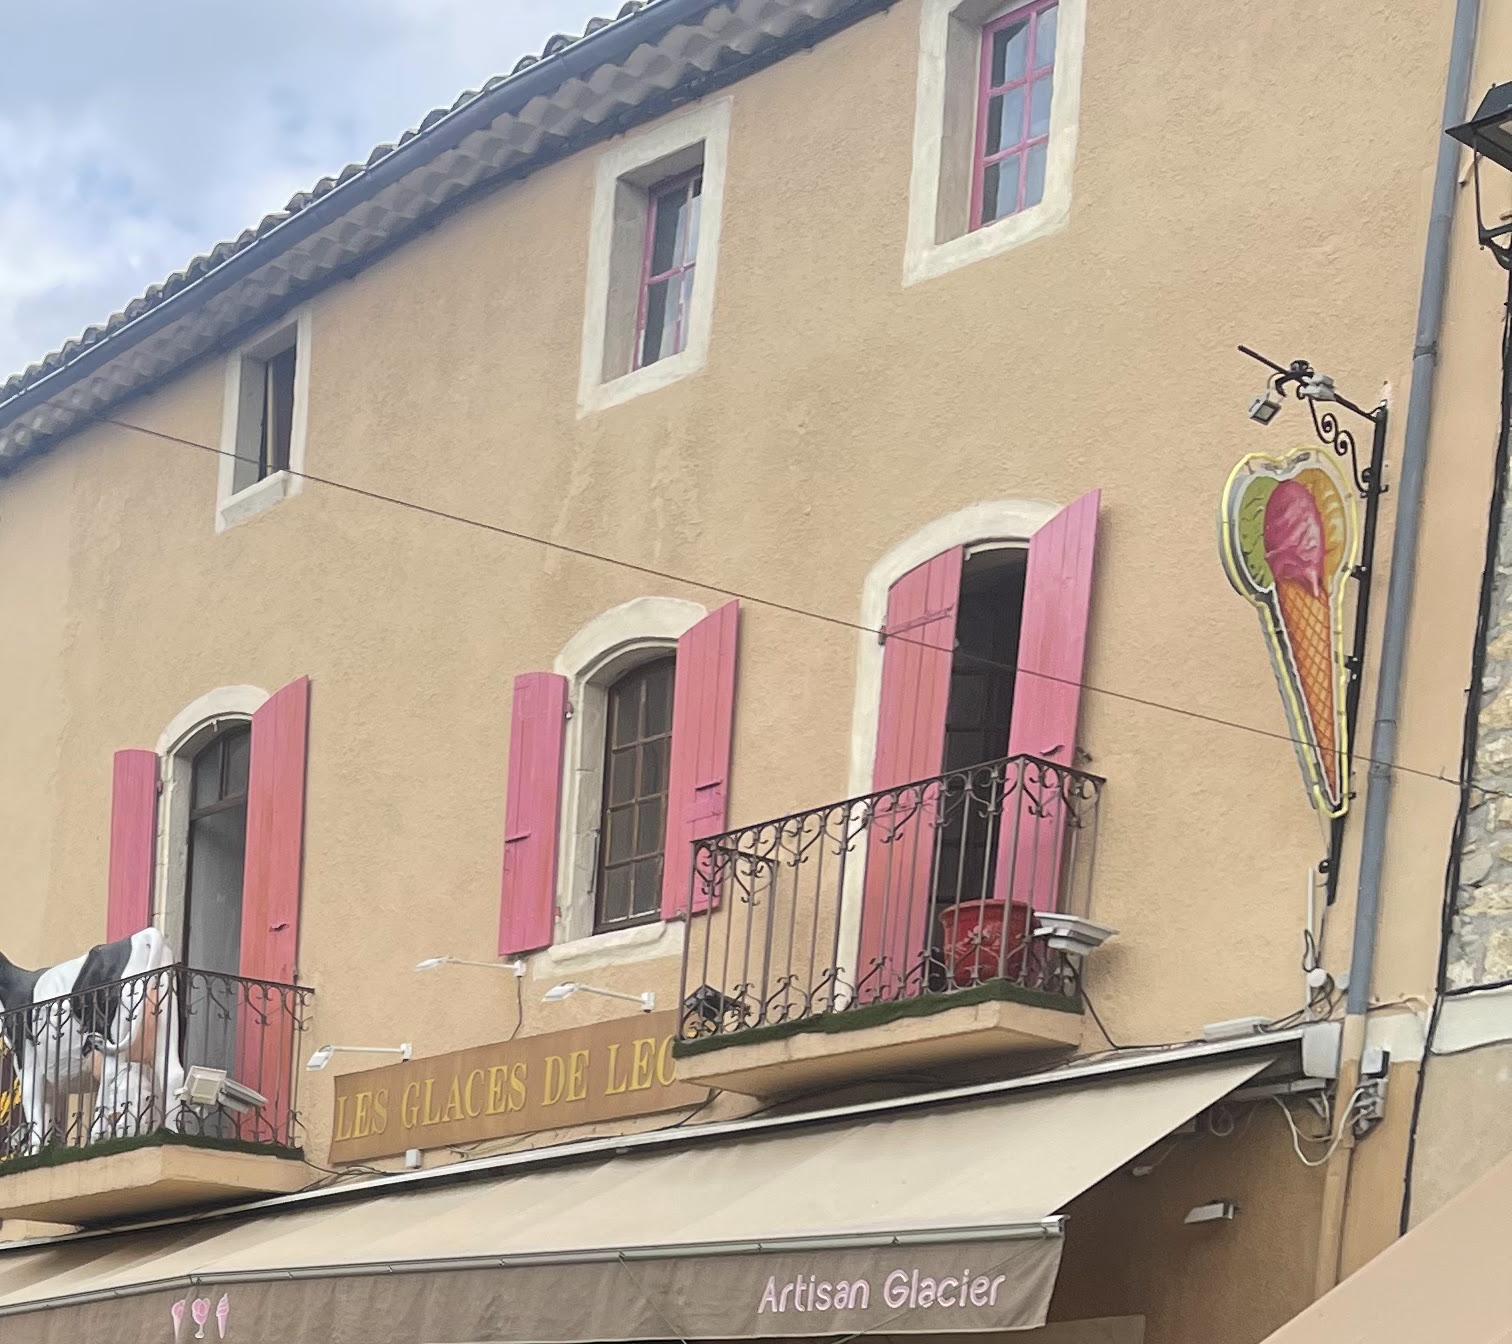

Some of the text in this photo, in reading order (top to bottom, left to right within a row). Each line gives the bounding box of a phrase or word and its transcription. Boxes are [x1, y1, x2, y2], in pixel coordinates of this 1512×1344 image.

[334, 1088, 390, 1142] LES
[400, 1062, 528, 1130] GLACES
[540, 1049, 590, 1107] DE
[757, 1267, 1006, 1314] Artisan Glacier
